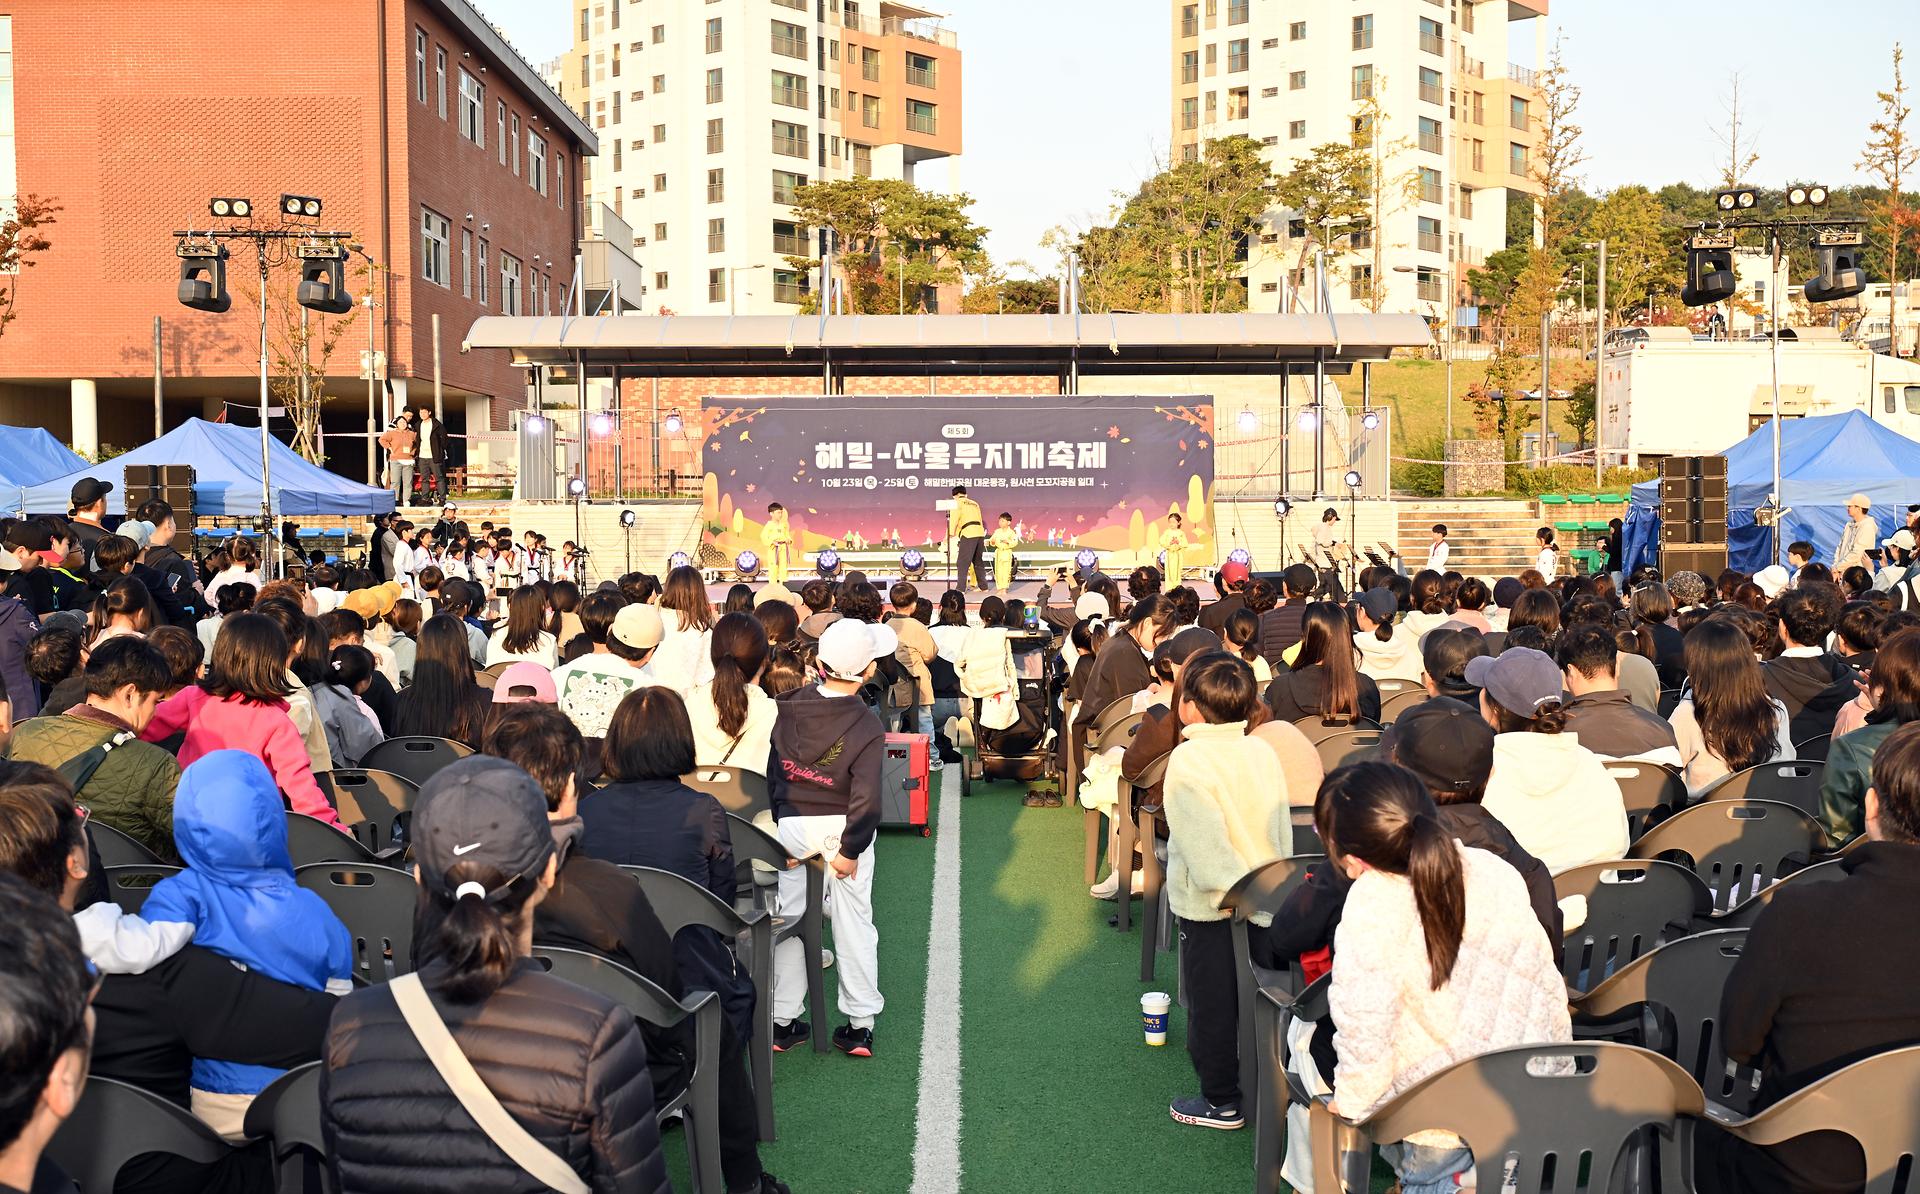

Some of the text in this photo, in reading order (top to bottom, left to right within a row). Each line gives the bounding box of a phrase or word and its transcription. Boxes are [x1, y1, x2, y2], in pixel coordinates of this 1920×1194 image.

[947, 427, 969, 435] 제5회
[821, 478, 841, 488] 10월
[1077, 477, 1095, 487] 일대
